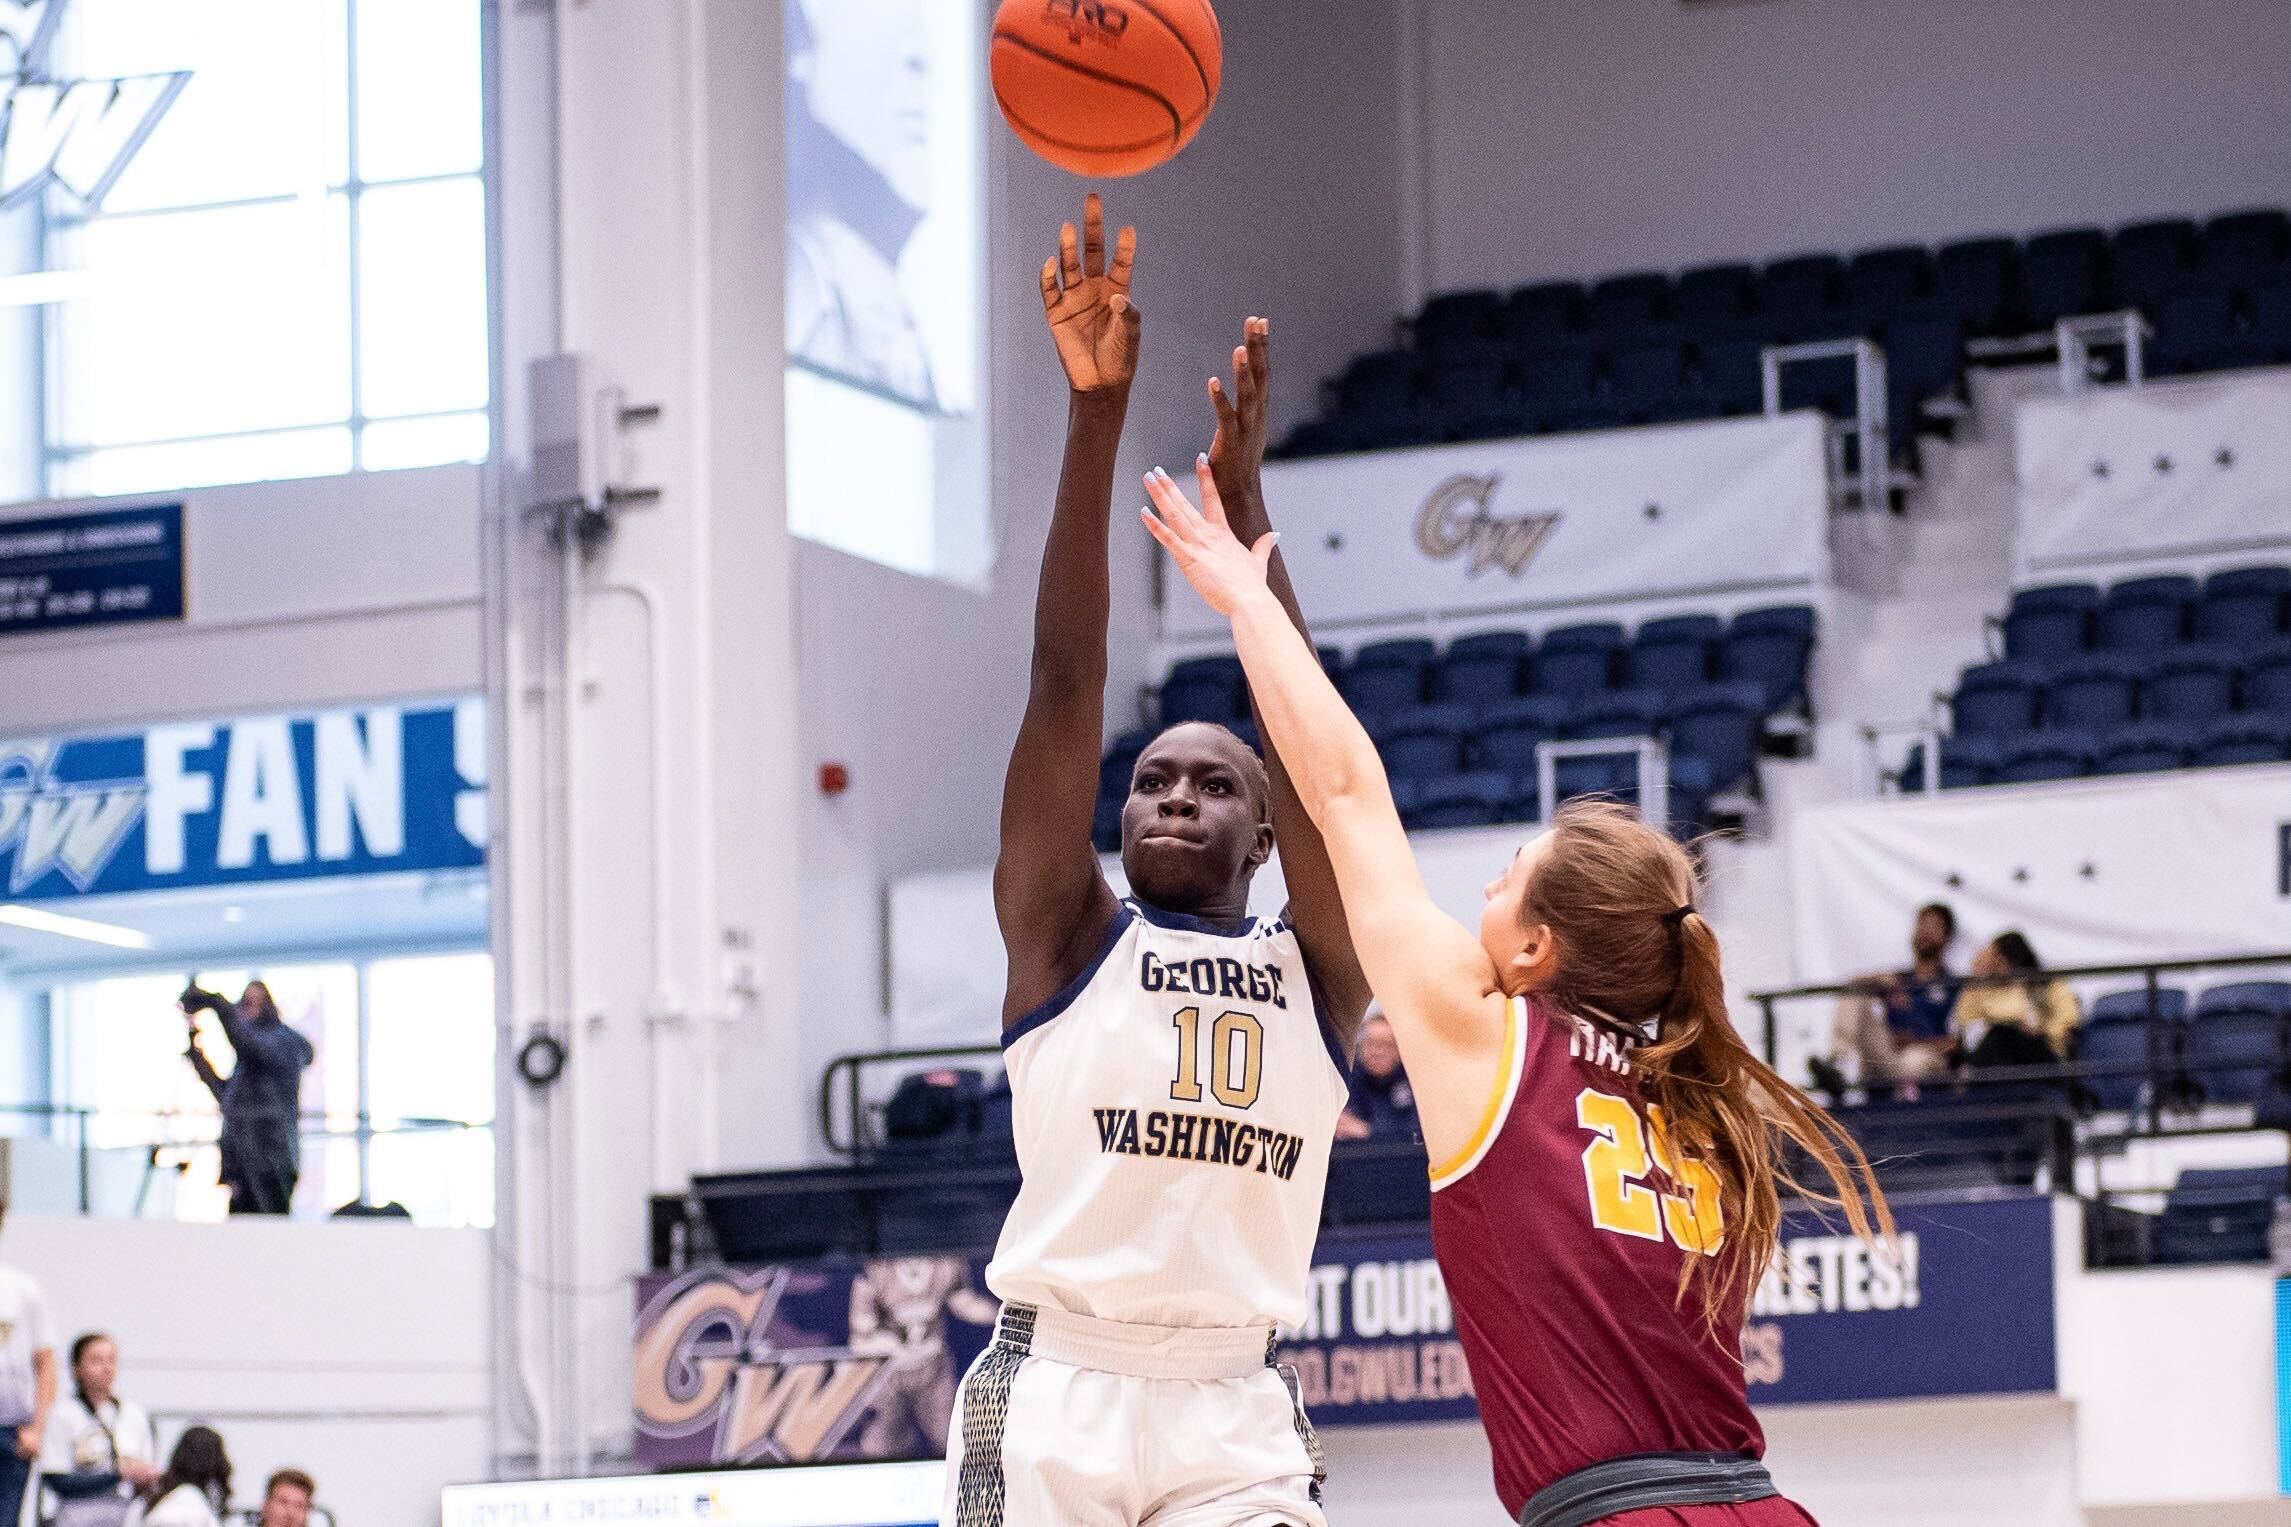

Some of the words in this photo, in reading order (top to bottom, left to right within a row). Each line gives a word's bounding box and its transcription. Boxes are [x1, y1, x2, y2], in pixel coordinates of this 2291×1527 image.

[1414, 471, 1562, 579] GW
[144, 708, 404, 875] FAN
[1141, 950, 1288, 1011] GEORGE
[1169, 1005, 1265, 1111] 10
[1091, 1106, 1305, 1181] WASHINGTON
[1575, 1086, 1725, 1258] 25
[1351, 1257, 1456, 1339] OUR
[632, 1262, 891, 1462] GW
